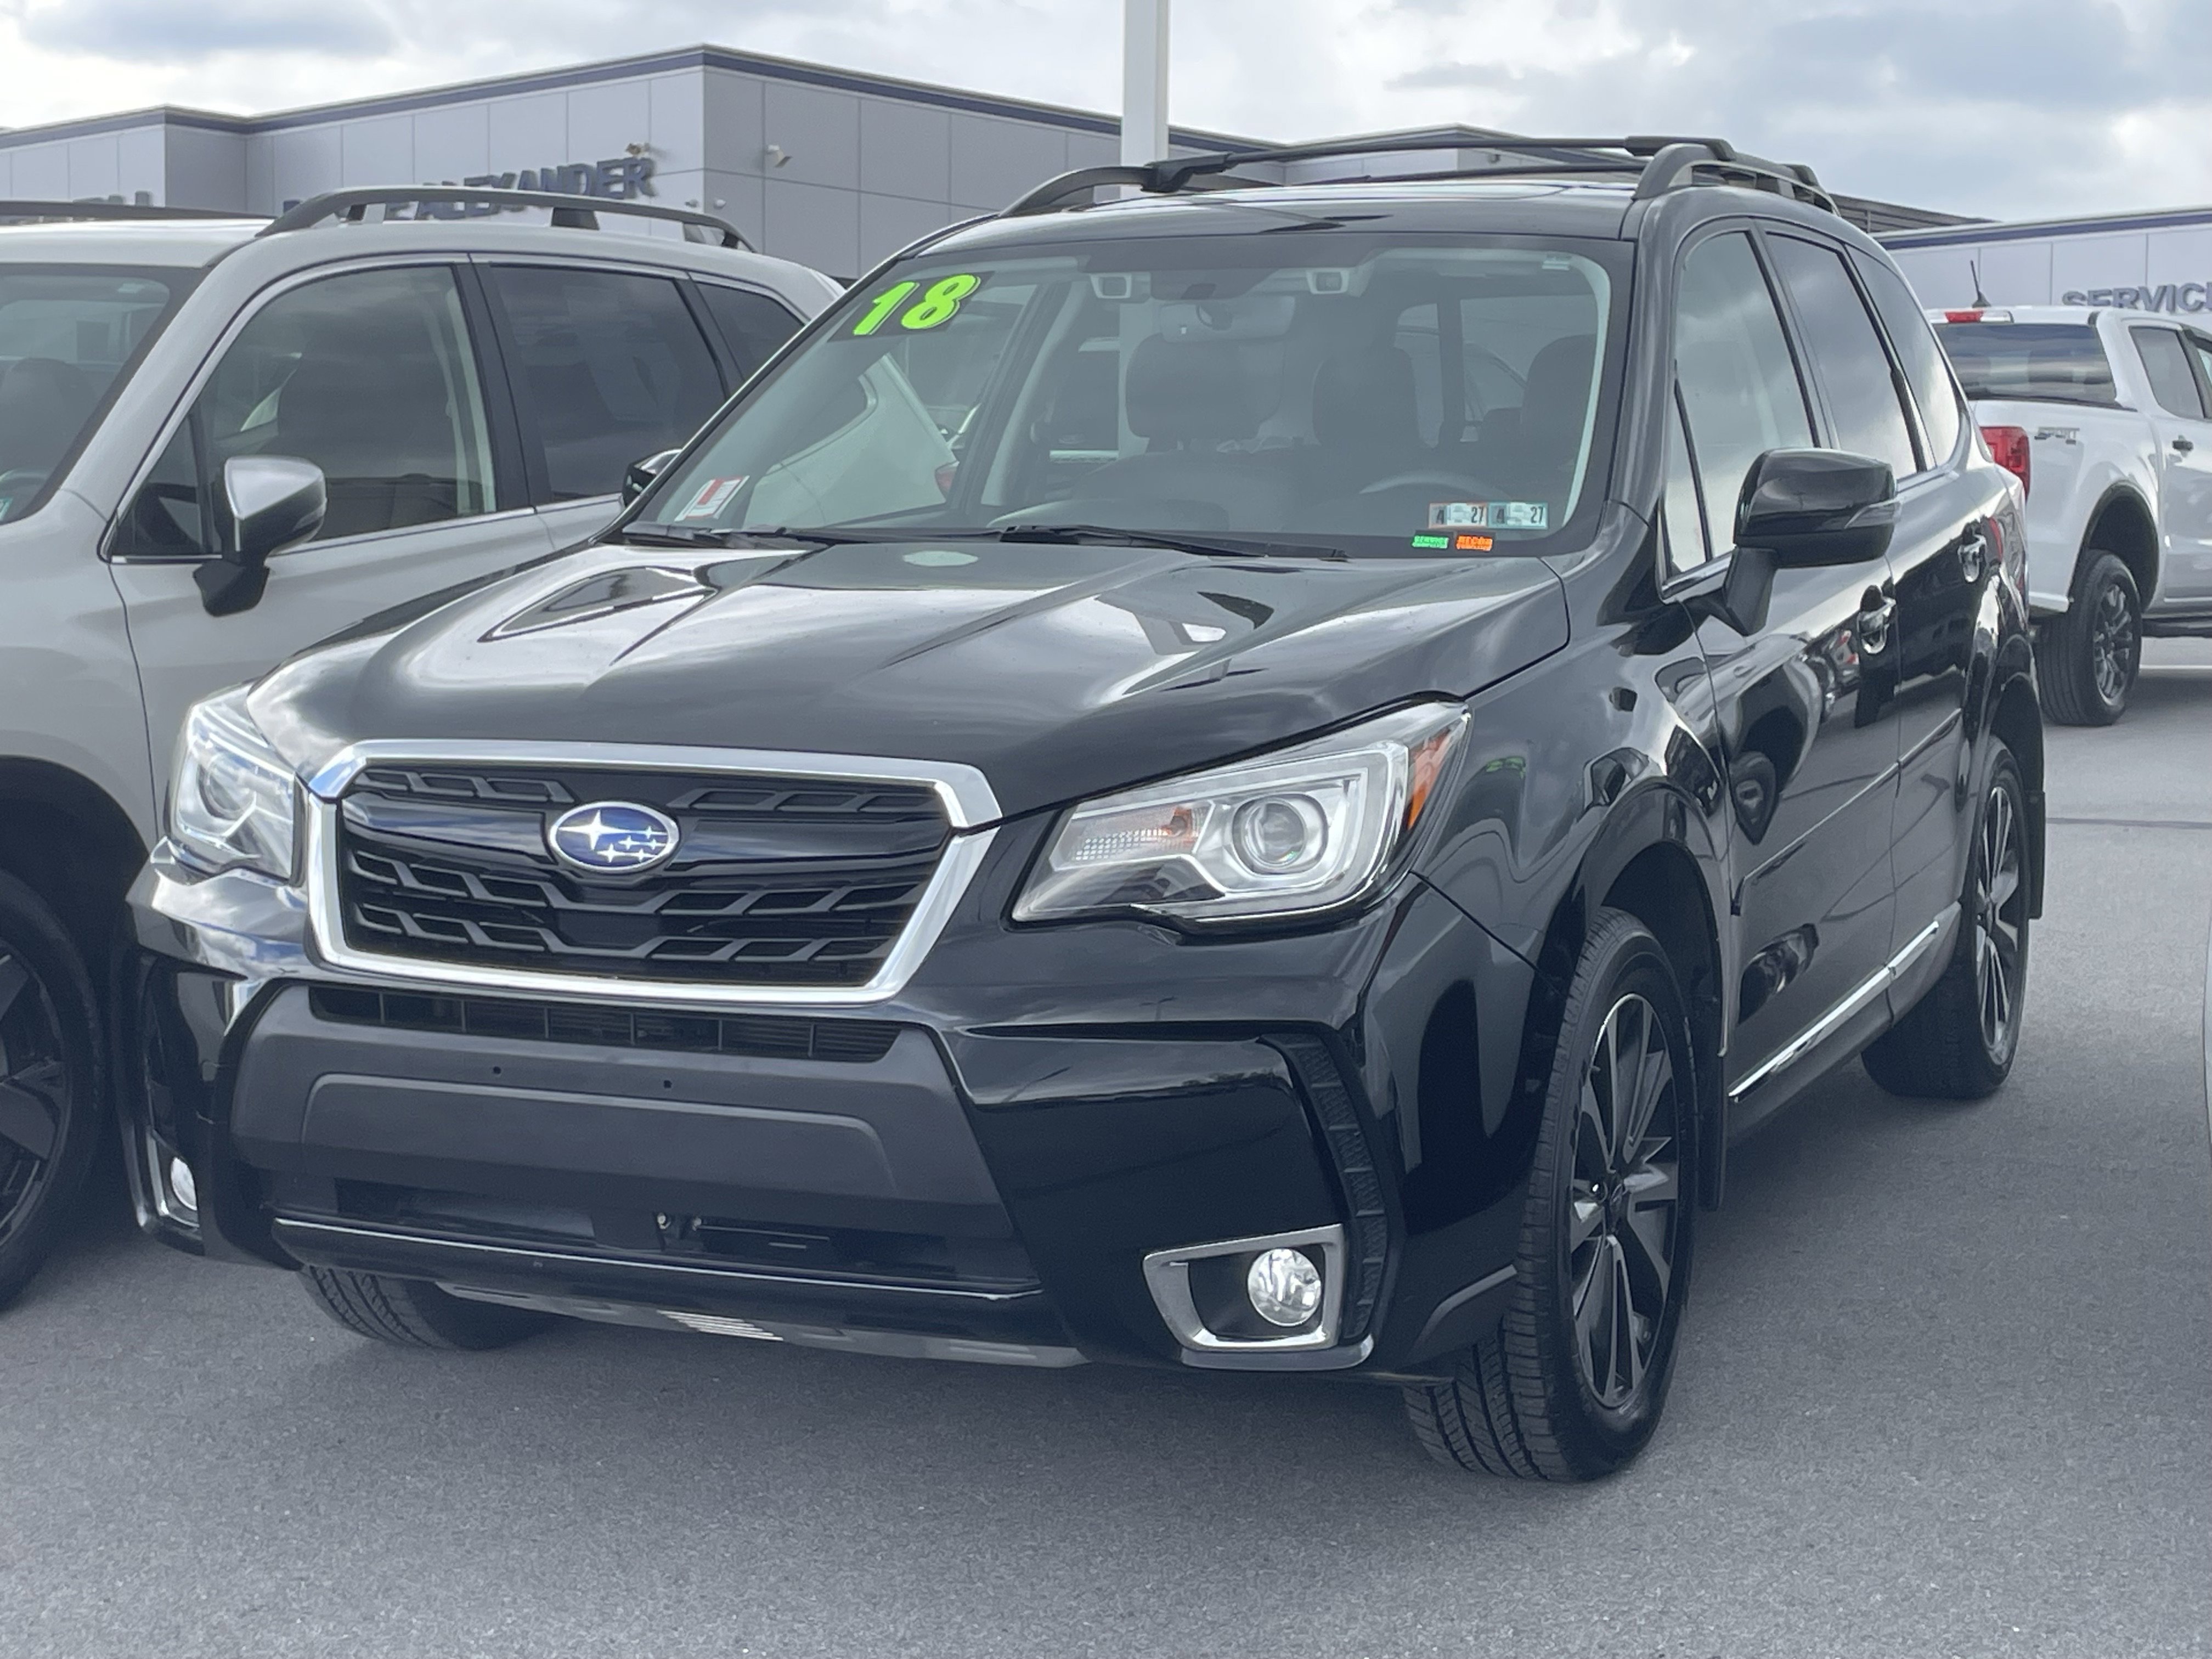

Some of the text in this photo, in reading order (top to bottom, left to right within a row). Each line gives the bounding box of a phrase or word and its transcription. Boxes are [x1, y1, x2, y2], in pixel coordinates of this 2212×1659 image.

[853, 273, 981, 336] 18
[2062, 281, 2212, 314] SERVIC
[1471, 506, 1484, 524] 27
[1530, 506, 1544, 524] 27
